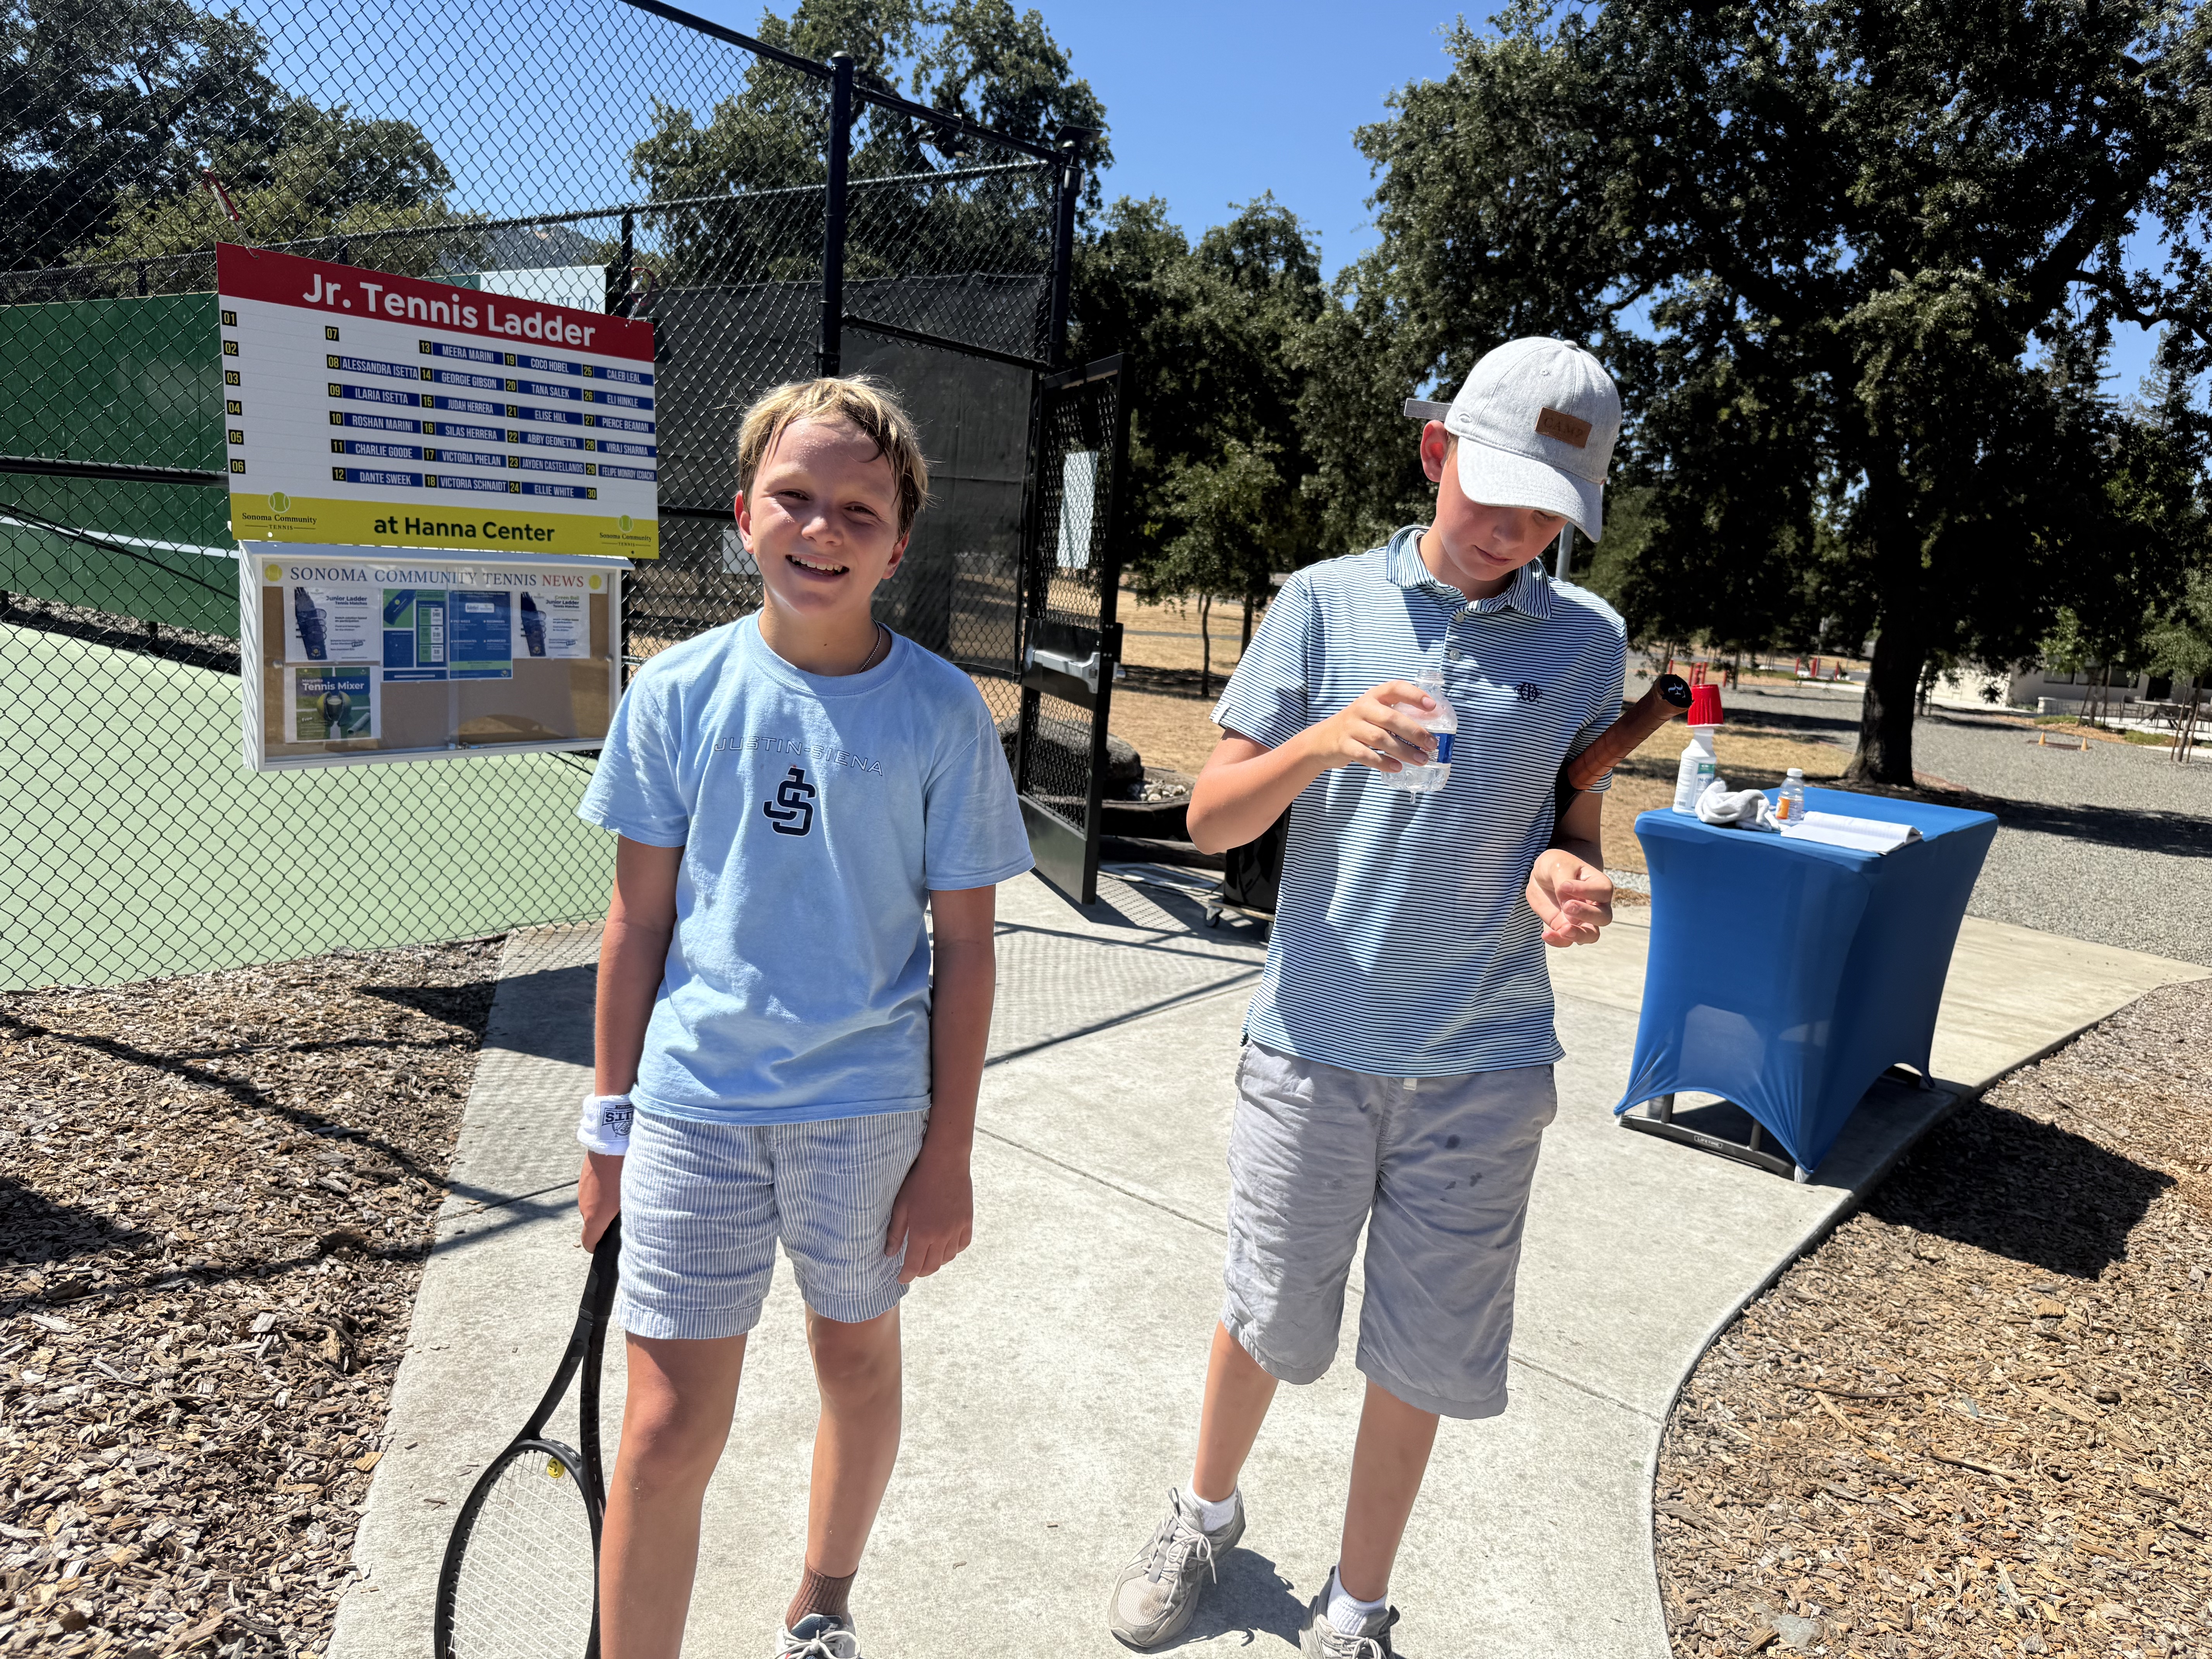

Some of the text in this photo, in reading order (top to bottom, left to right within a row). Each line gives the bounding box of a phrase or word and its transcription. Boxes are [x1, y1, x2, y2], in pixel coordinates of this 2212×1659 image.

[302, 273, 351, 308] Jr.
[360, 282, 478, 328] Tennis
[488, 304, 596, 347] Ladder
[224, 313, 235, 325] 01
[327, 328, 337, 340] 07
[225, 343, 237, 354] 02
[421, 342, 494, 362] 13 MEERA MARINI
[328, 357, 418, 379] 08 ALESSANDRA ISETTA
[506, 355, 569, 373] 19 COCO HOBEL
[227, 373, 238, 384] 03
[422, 369, 496, 389] 14 GEORGIE GIBSON
[584, 366, 641, 383] 25 CALEB LEAL
[330, 385, 409, 405] 09 ILARIA ISETTA
[507, 380, 570, 398] 20 TANA SALEK
[423, 397, 494, 414] 15 JUDAH HERRERA
[584, 392, 638, 407] 26 ELI HINKLE
[228, 402, 240, 414] 04
[508, 407, 567, 423] 21 ELISE HILL
[331, 413, 413, 432] 10 ROSHAN MARINI
[585, 416, 649, 432] 27 PIERCE BEAMAN
[1544, 417, 1583, 438] CAMP
[230, 431, 242, 443] 05
[424, 423, 497, 440] 16 SILAS HERRERA
[508, 432, 577, 448] 22 ABBY GEONETTA
[586, 440, 648, 456] 28 VIRAJ SHARMA
[333, 441, 413, 458] 11 CHARLIE GOODE
[232, 460, 244, 472] 06
[425, 450, 501, 466] 17 VICTORIA PHELAN
[509, 457, 583, 473] 23 JAYDEN CASTELLANOS
[335, 469, 411, 485] 12 DANTE SWEEK
[587, 464, 654, 480] 29 FELIPE MONROY (COACH)
[426, 476, 507, 491] 18 VICTORIA SCHNAIDT
[510, 483, 574, 497] 24 ELLIE WHITE
[588, 489, 596, 499] 30
[242, 512, 317, 525] Sonoma Community
[374, 516, 555, 542] at Hanna Center
[622, 534, 651, 542] Community
[290, 567, 584, 587] SONOMA COMMUNITY TENNIS NEWS
[302, 682, 364, 691] Tennis Mixer
[714, 736, 883, 776] JUSTIN-SIENA
